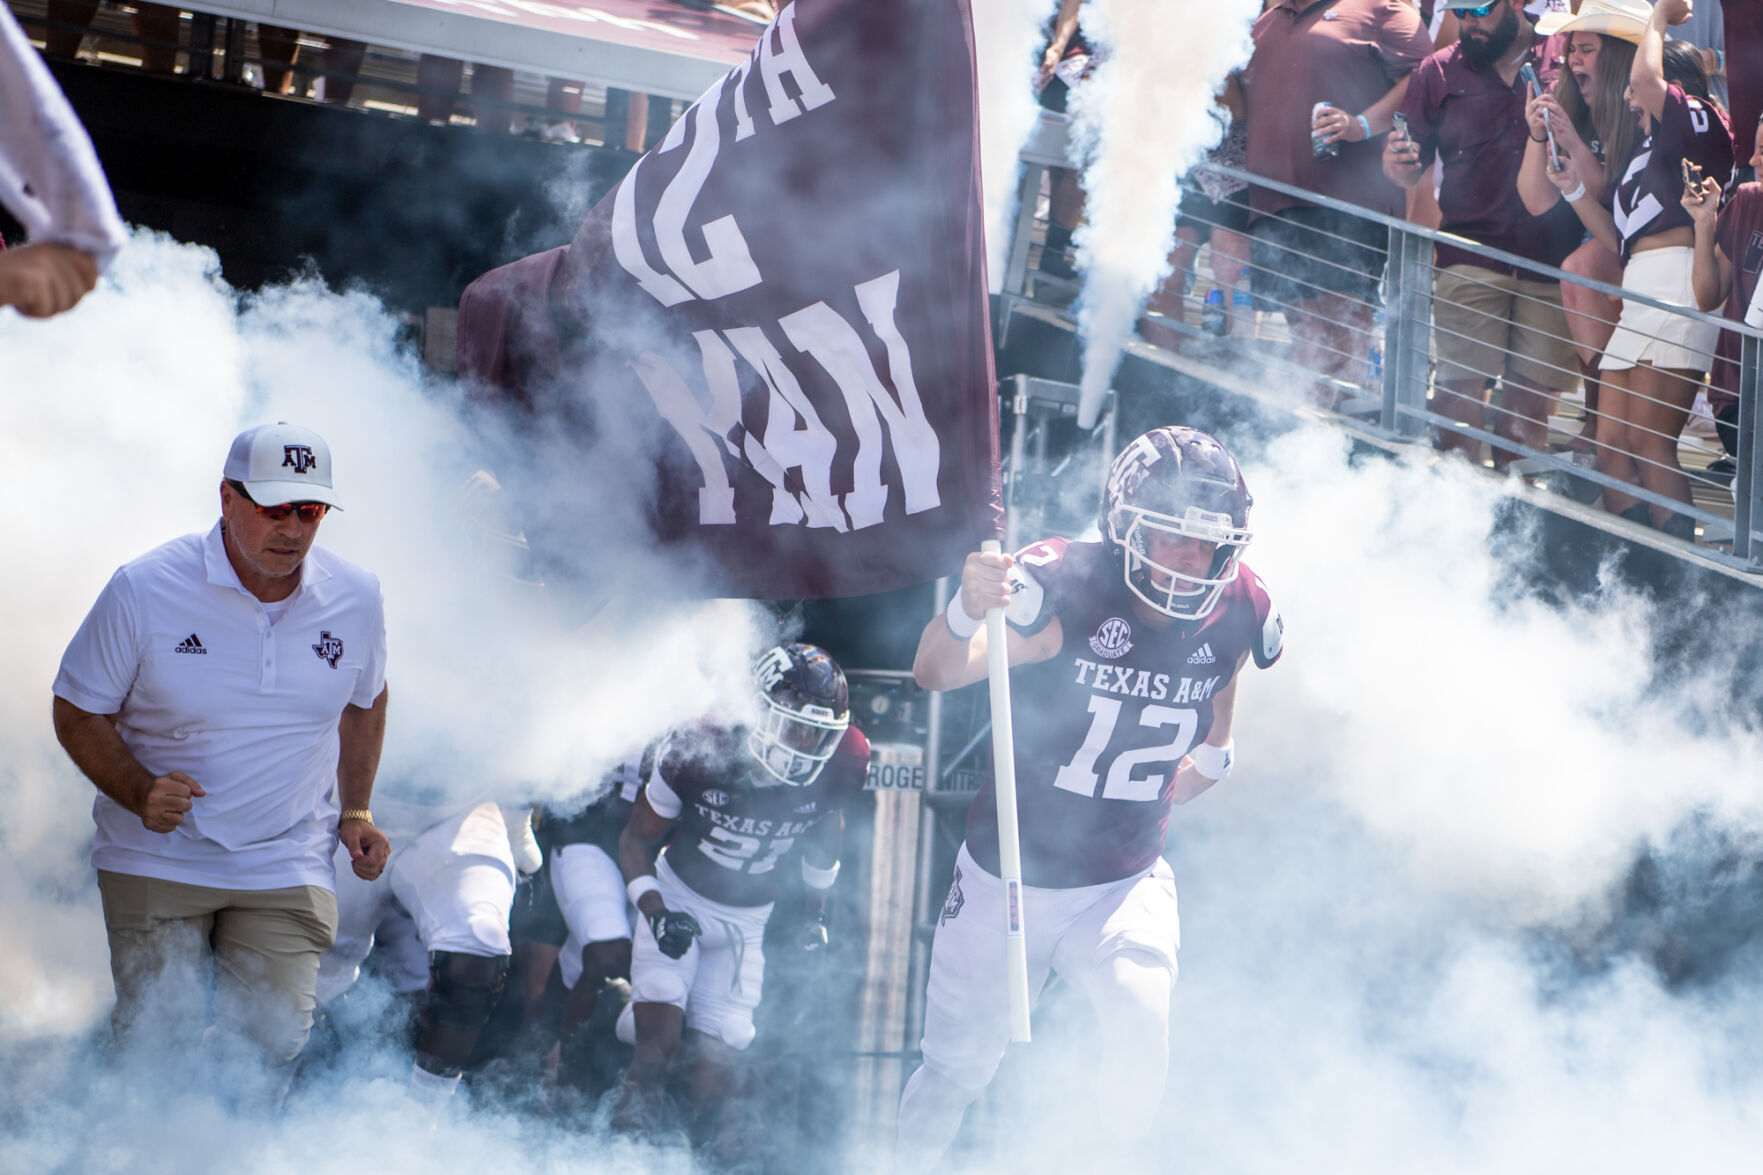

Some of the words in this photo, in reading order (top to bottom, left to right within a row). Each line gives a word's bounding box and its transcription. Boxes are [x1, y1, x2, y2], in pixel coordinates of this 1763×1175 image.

[627, 269, 942, 534] MAN
[1100, 619, 1129, 649] SEC
[175, 646, 207, 655] adidas
[1187, 655, 1216, 665] adidas
[1074, 657, 1170, 701] TEXAS
[1173, 675, 1221, 704] A&M
[1053, 694, 1198, 803] 12
[703, 791, 728, 806] SEC
[694, 803, 773, 836] TEXAS
